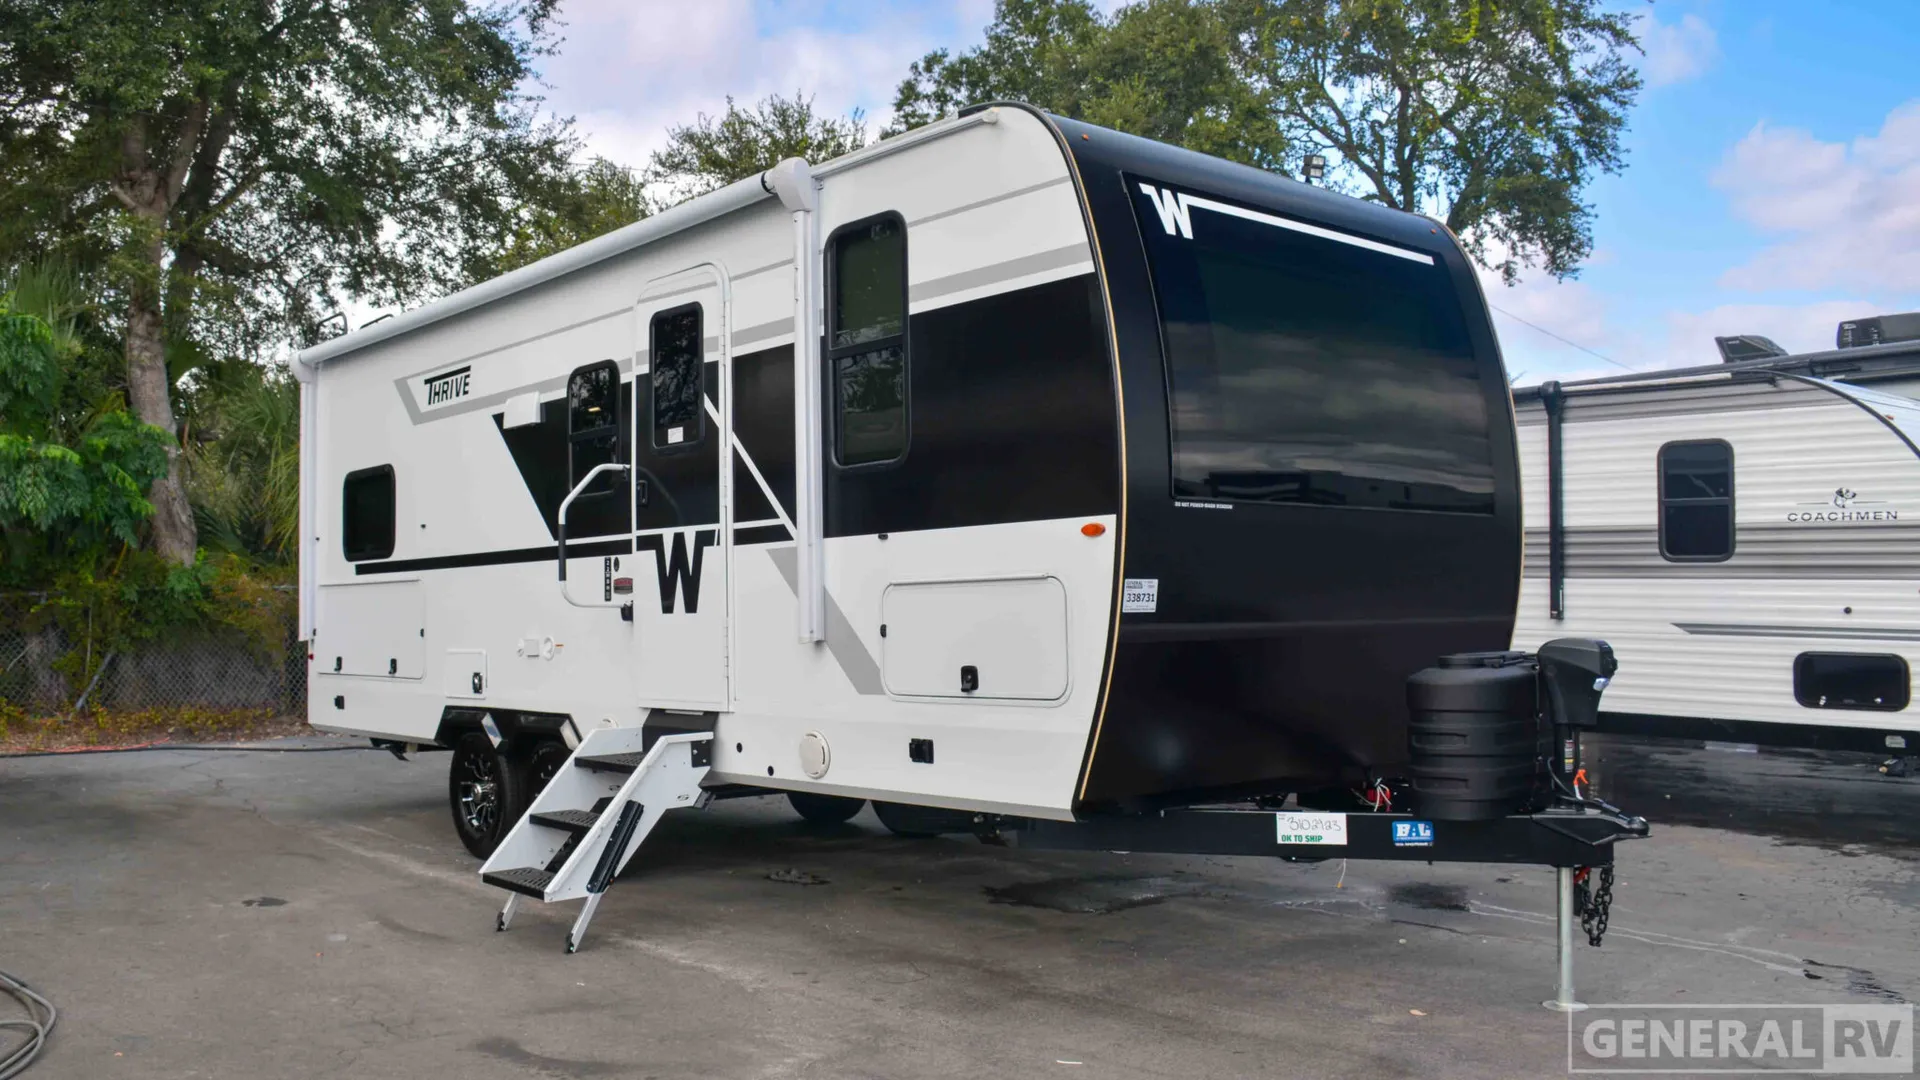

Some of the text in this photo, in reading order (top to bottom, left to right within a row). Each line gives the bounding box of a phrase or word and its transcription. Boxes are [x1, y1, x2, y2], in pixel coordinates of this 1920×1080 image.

[1138, 182, 1194, 240] W
[424, 365, 471, 405] THRIVE
[1787, 511, 1898, 522] COACHMEN
[640, 529, 716, 615] W
[1126, 592, 1155, 603] 338731
[1395, 823, 1431, 837] BAL
[1281, 834, 1323, 843] OK TO SHIP
